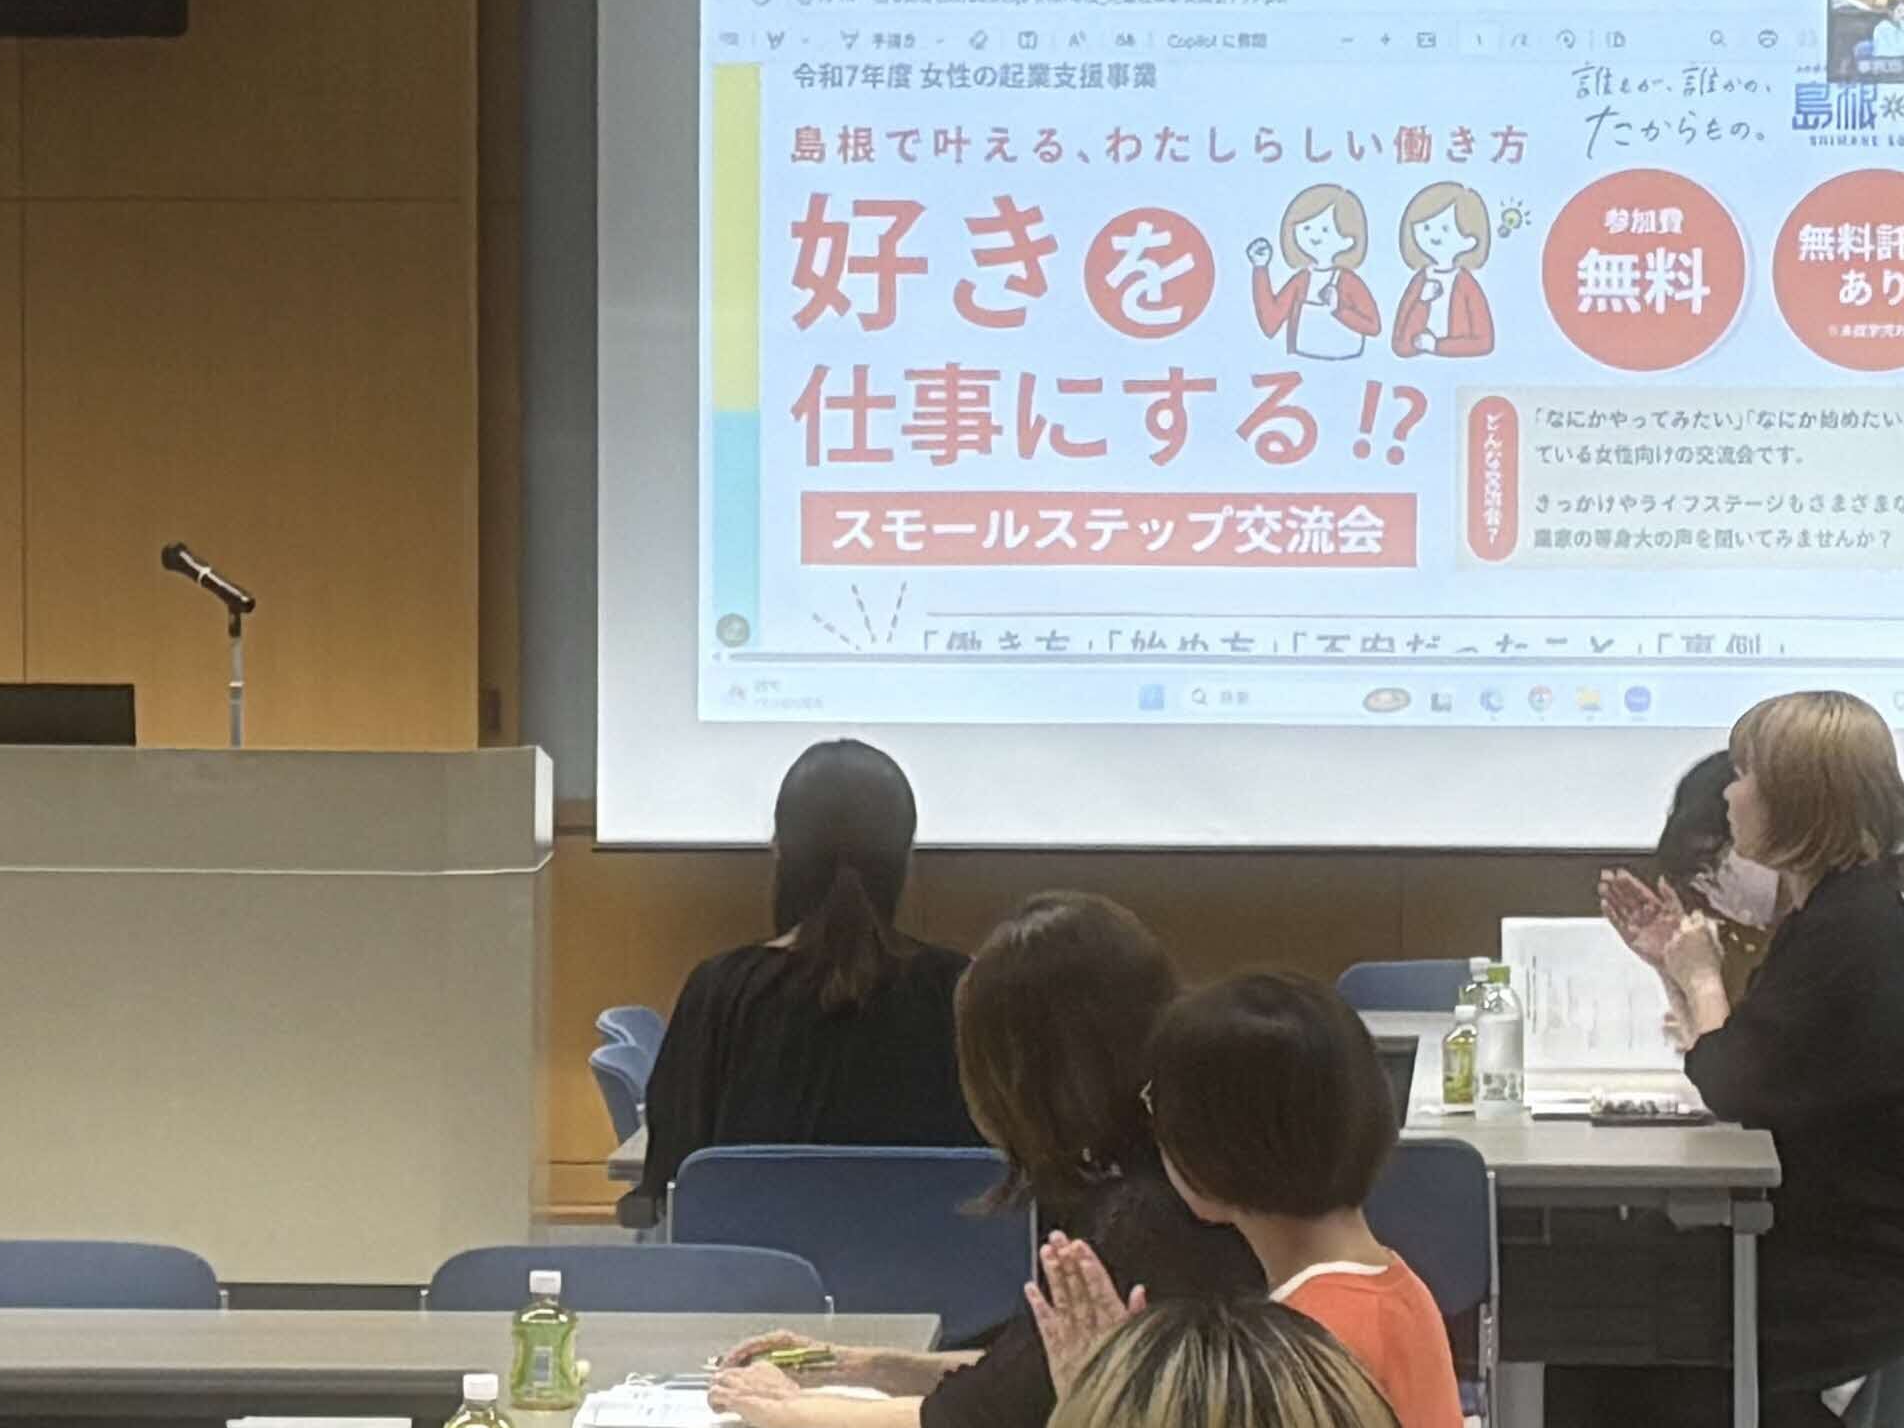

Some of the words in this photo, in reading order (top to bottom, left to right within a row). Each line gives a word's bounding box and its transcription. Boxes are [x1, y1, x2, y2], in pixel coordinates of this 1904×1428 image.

[793, 61, 912, 90] 令和7年度
[920, 61, 1158, 90] 女性の起業支援事業
[790, 125, 1529, 164] 島根で叶える、わたしらしい働き方
[1585, 104, 1766, 160] たからもの。
[1604, 207, 1685, 235] 参加費
[791, 192, 1196, 334] 好きを
[1576, 247, 1711, 316] 無料
[1534, 444, 1804, 466] ている女性向けの交流会です。
[831, 506, 1386, 556] スモールステップ交流会
